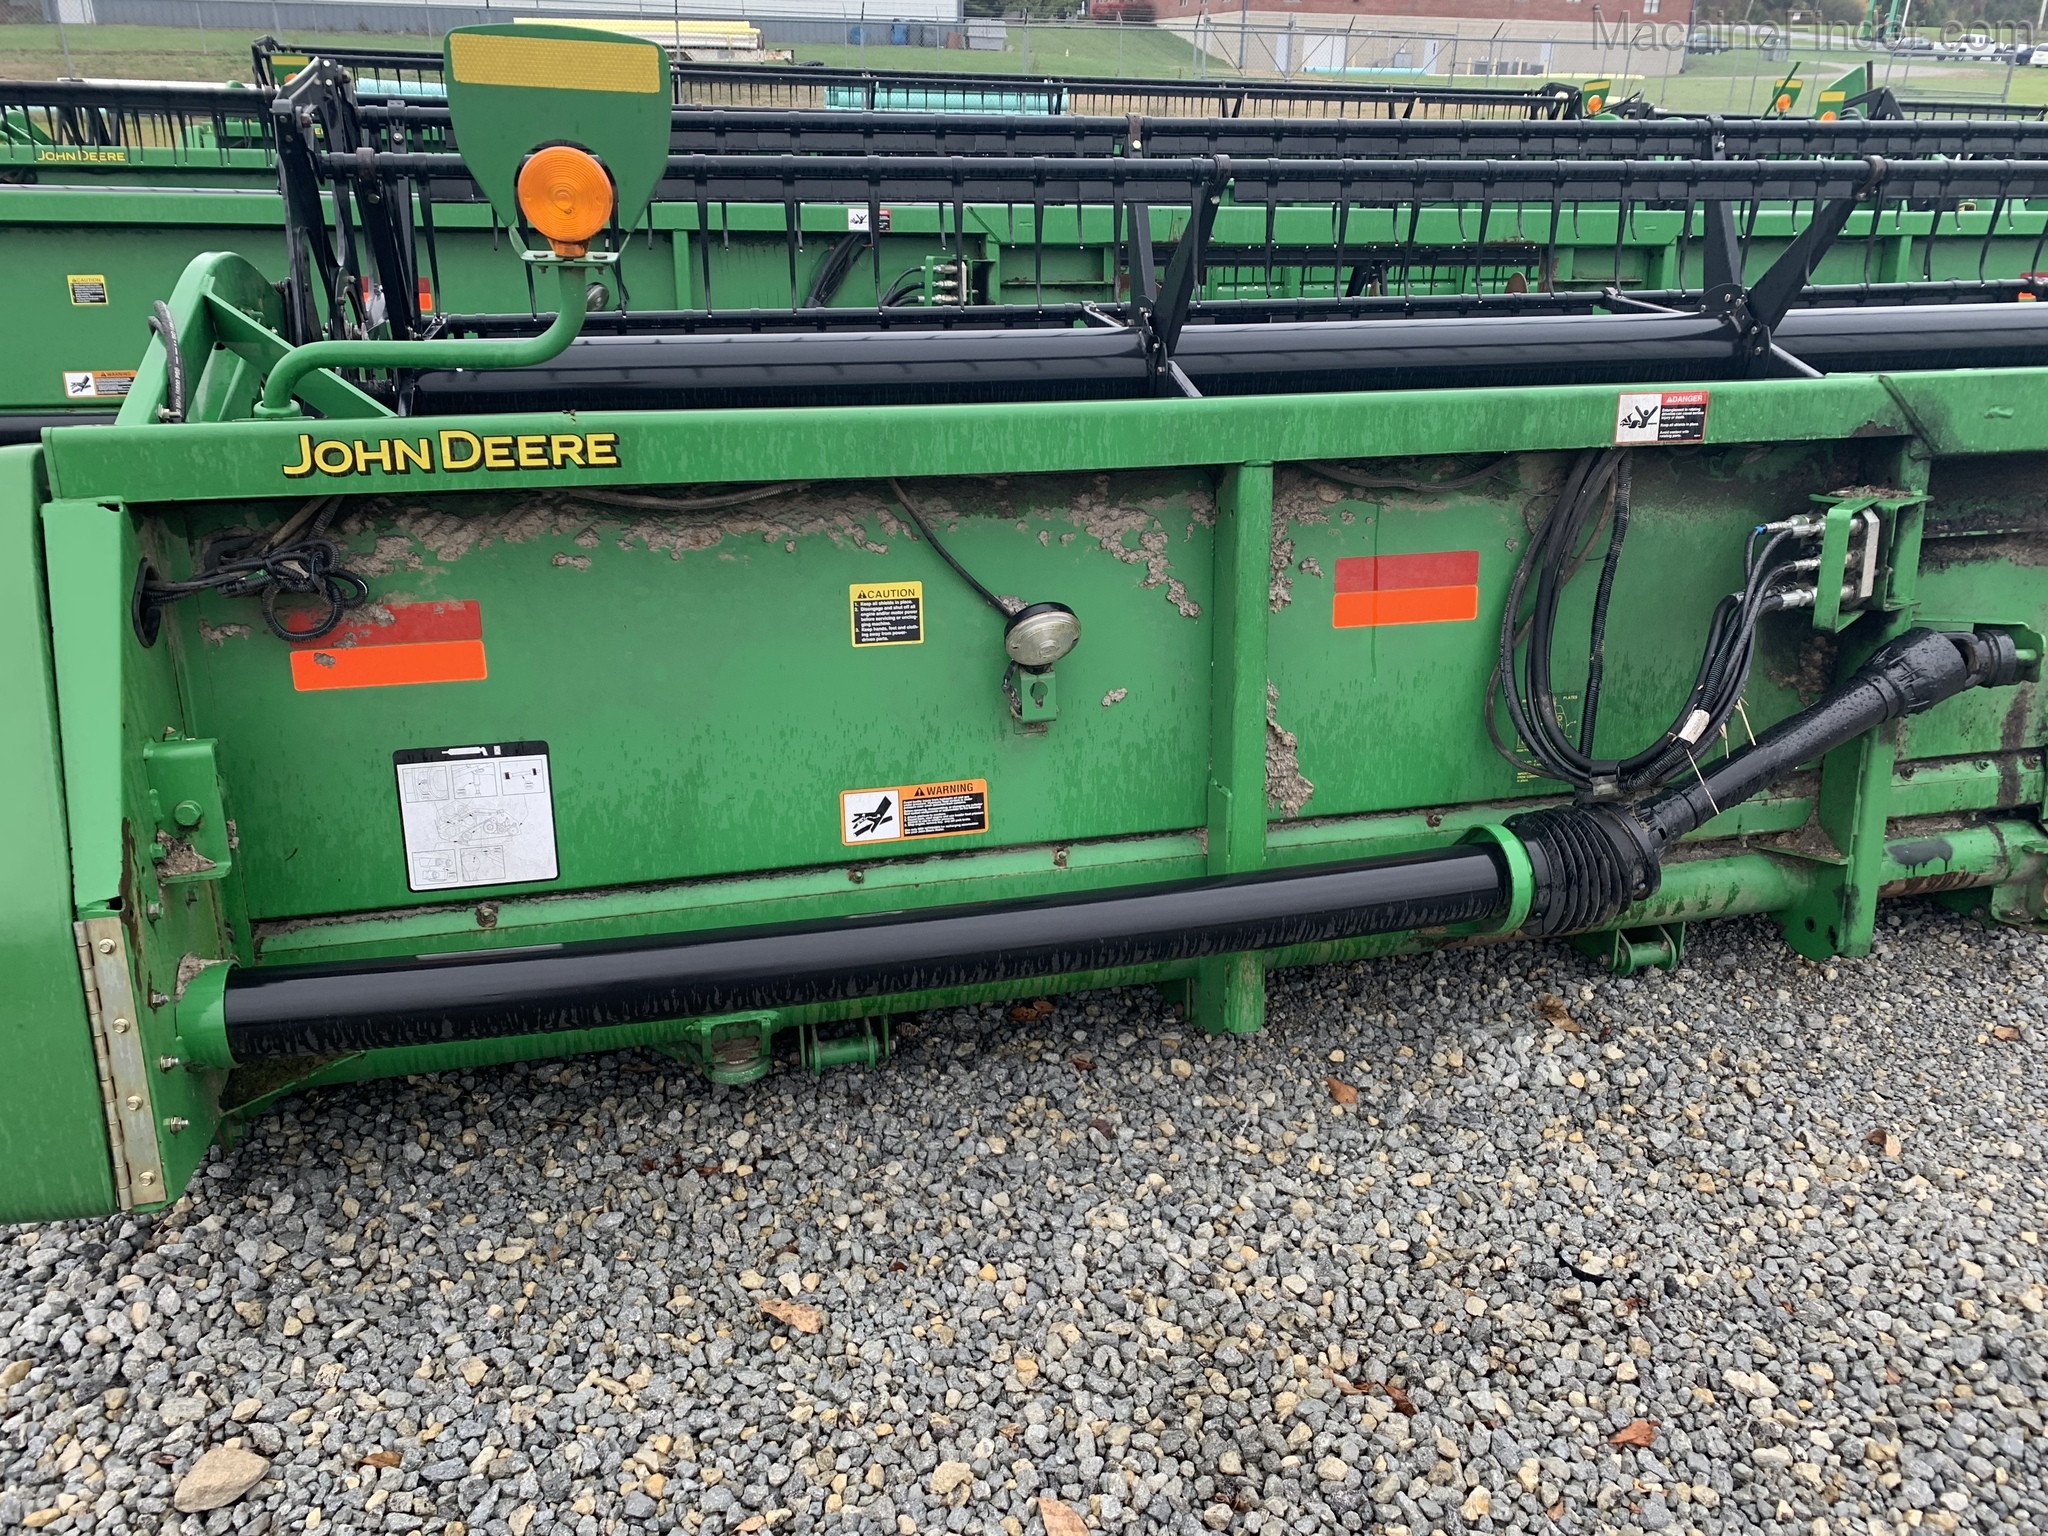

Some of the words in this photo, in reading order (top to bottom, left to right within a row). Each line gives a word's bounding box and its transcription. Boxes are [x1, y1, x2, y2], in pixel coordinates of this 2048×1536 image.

[38, 150, 76, 161] JOHN
[78, 150, 125, 161] DEERE
[282, 433, 435, 477] JOHN
[438, 429, 621, 471] DEERE
[867, 589, 915, 598] CAUTION
[926, 783, 973, 796] WARNING
